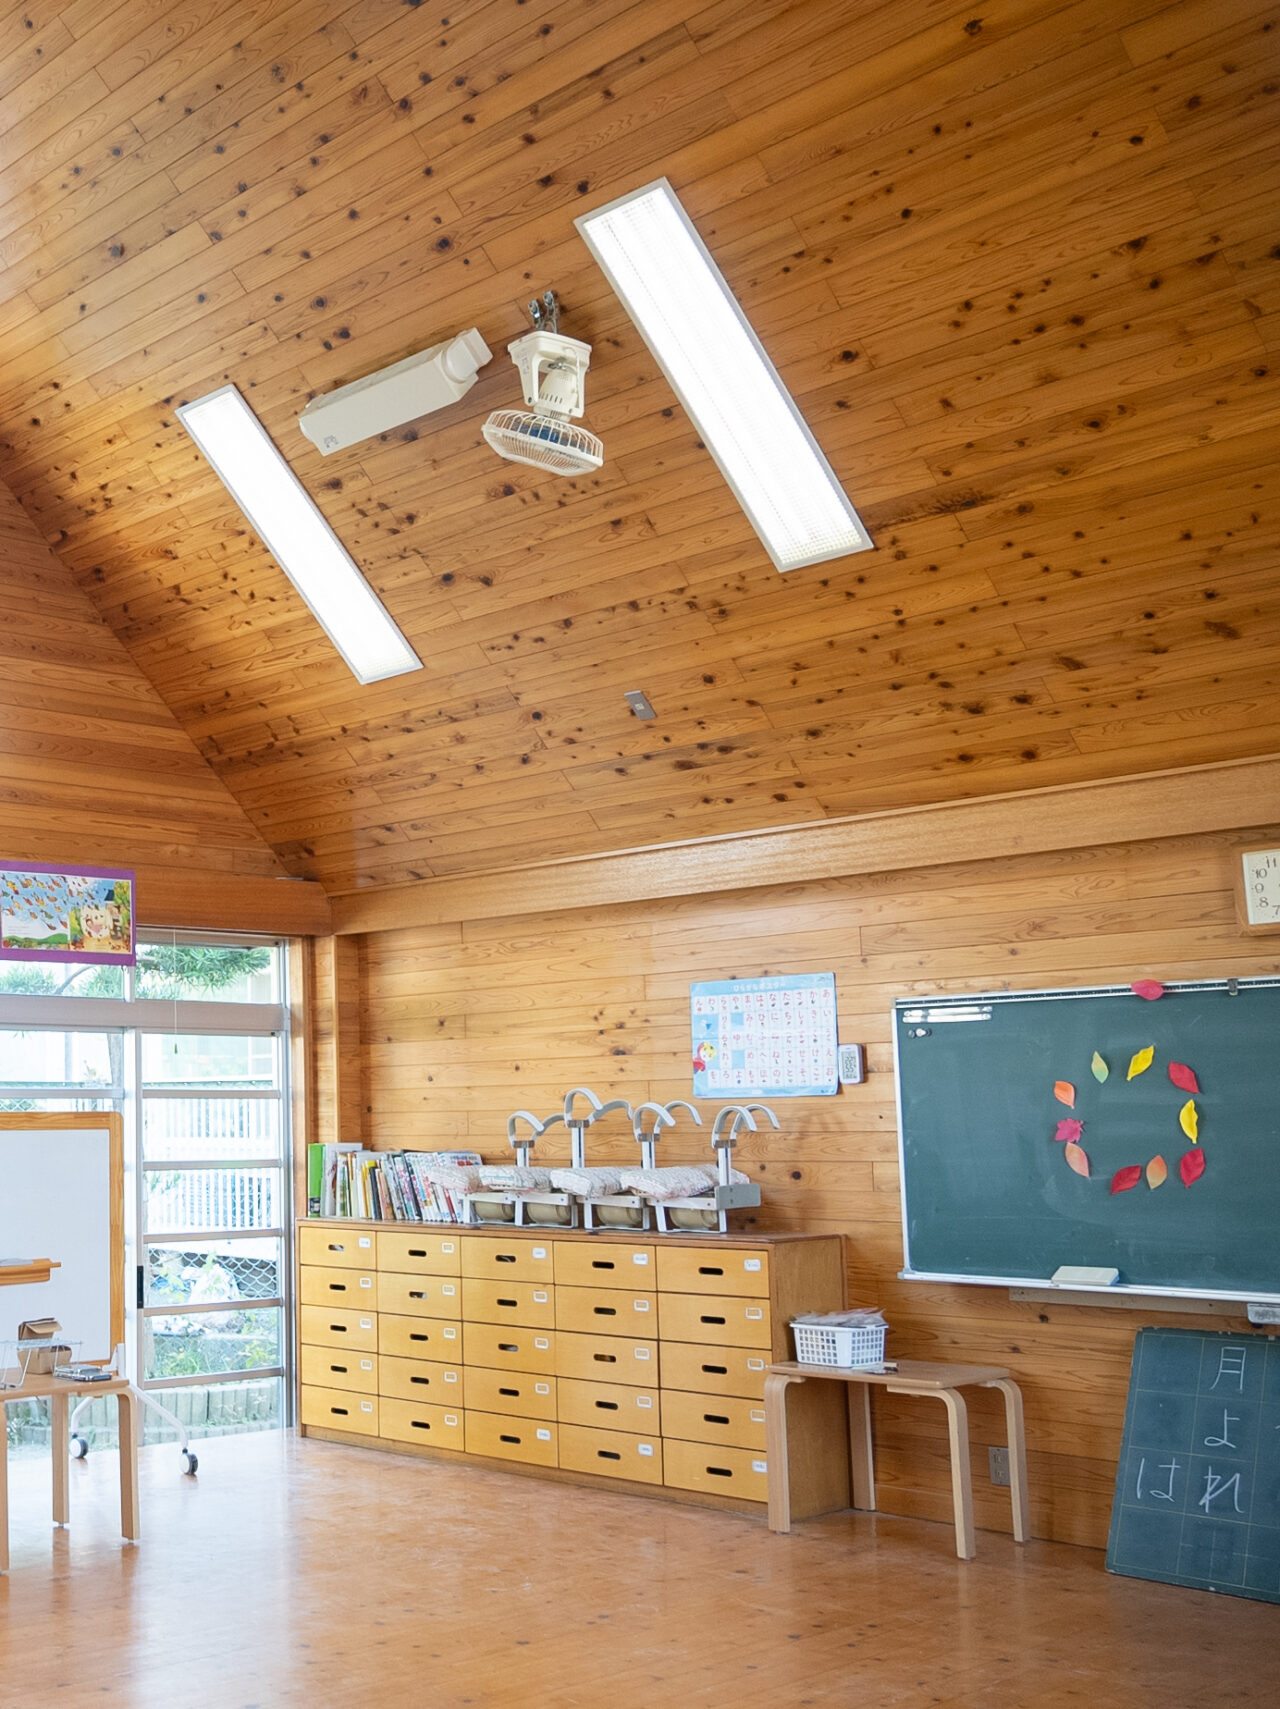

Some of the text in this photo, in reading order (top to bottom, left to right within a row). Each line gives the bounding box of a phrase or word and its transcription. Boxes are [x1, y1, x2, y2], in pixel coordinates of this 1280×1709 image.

[1266, 856, 1277, 868] 11
[1256, 868, 1268, 879] 10
[1254, 882, 1264, 894] 9
[1259, 896, 1269, 908] 8
[1209, 1346, 1247, 1393] 月
